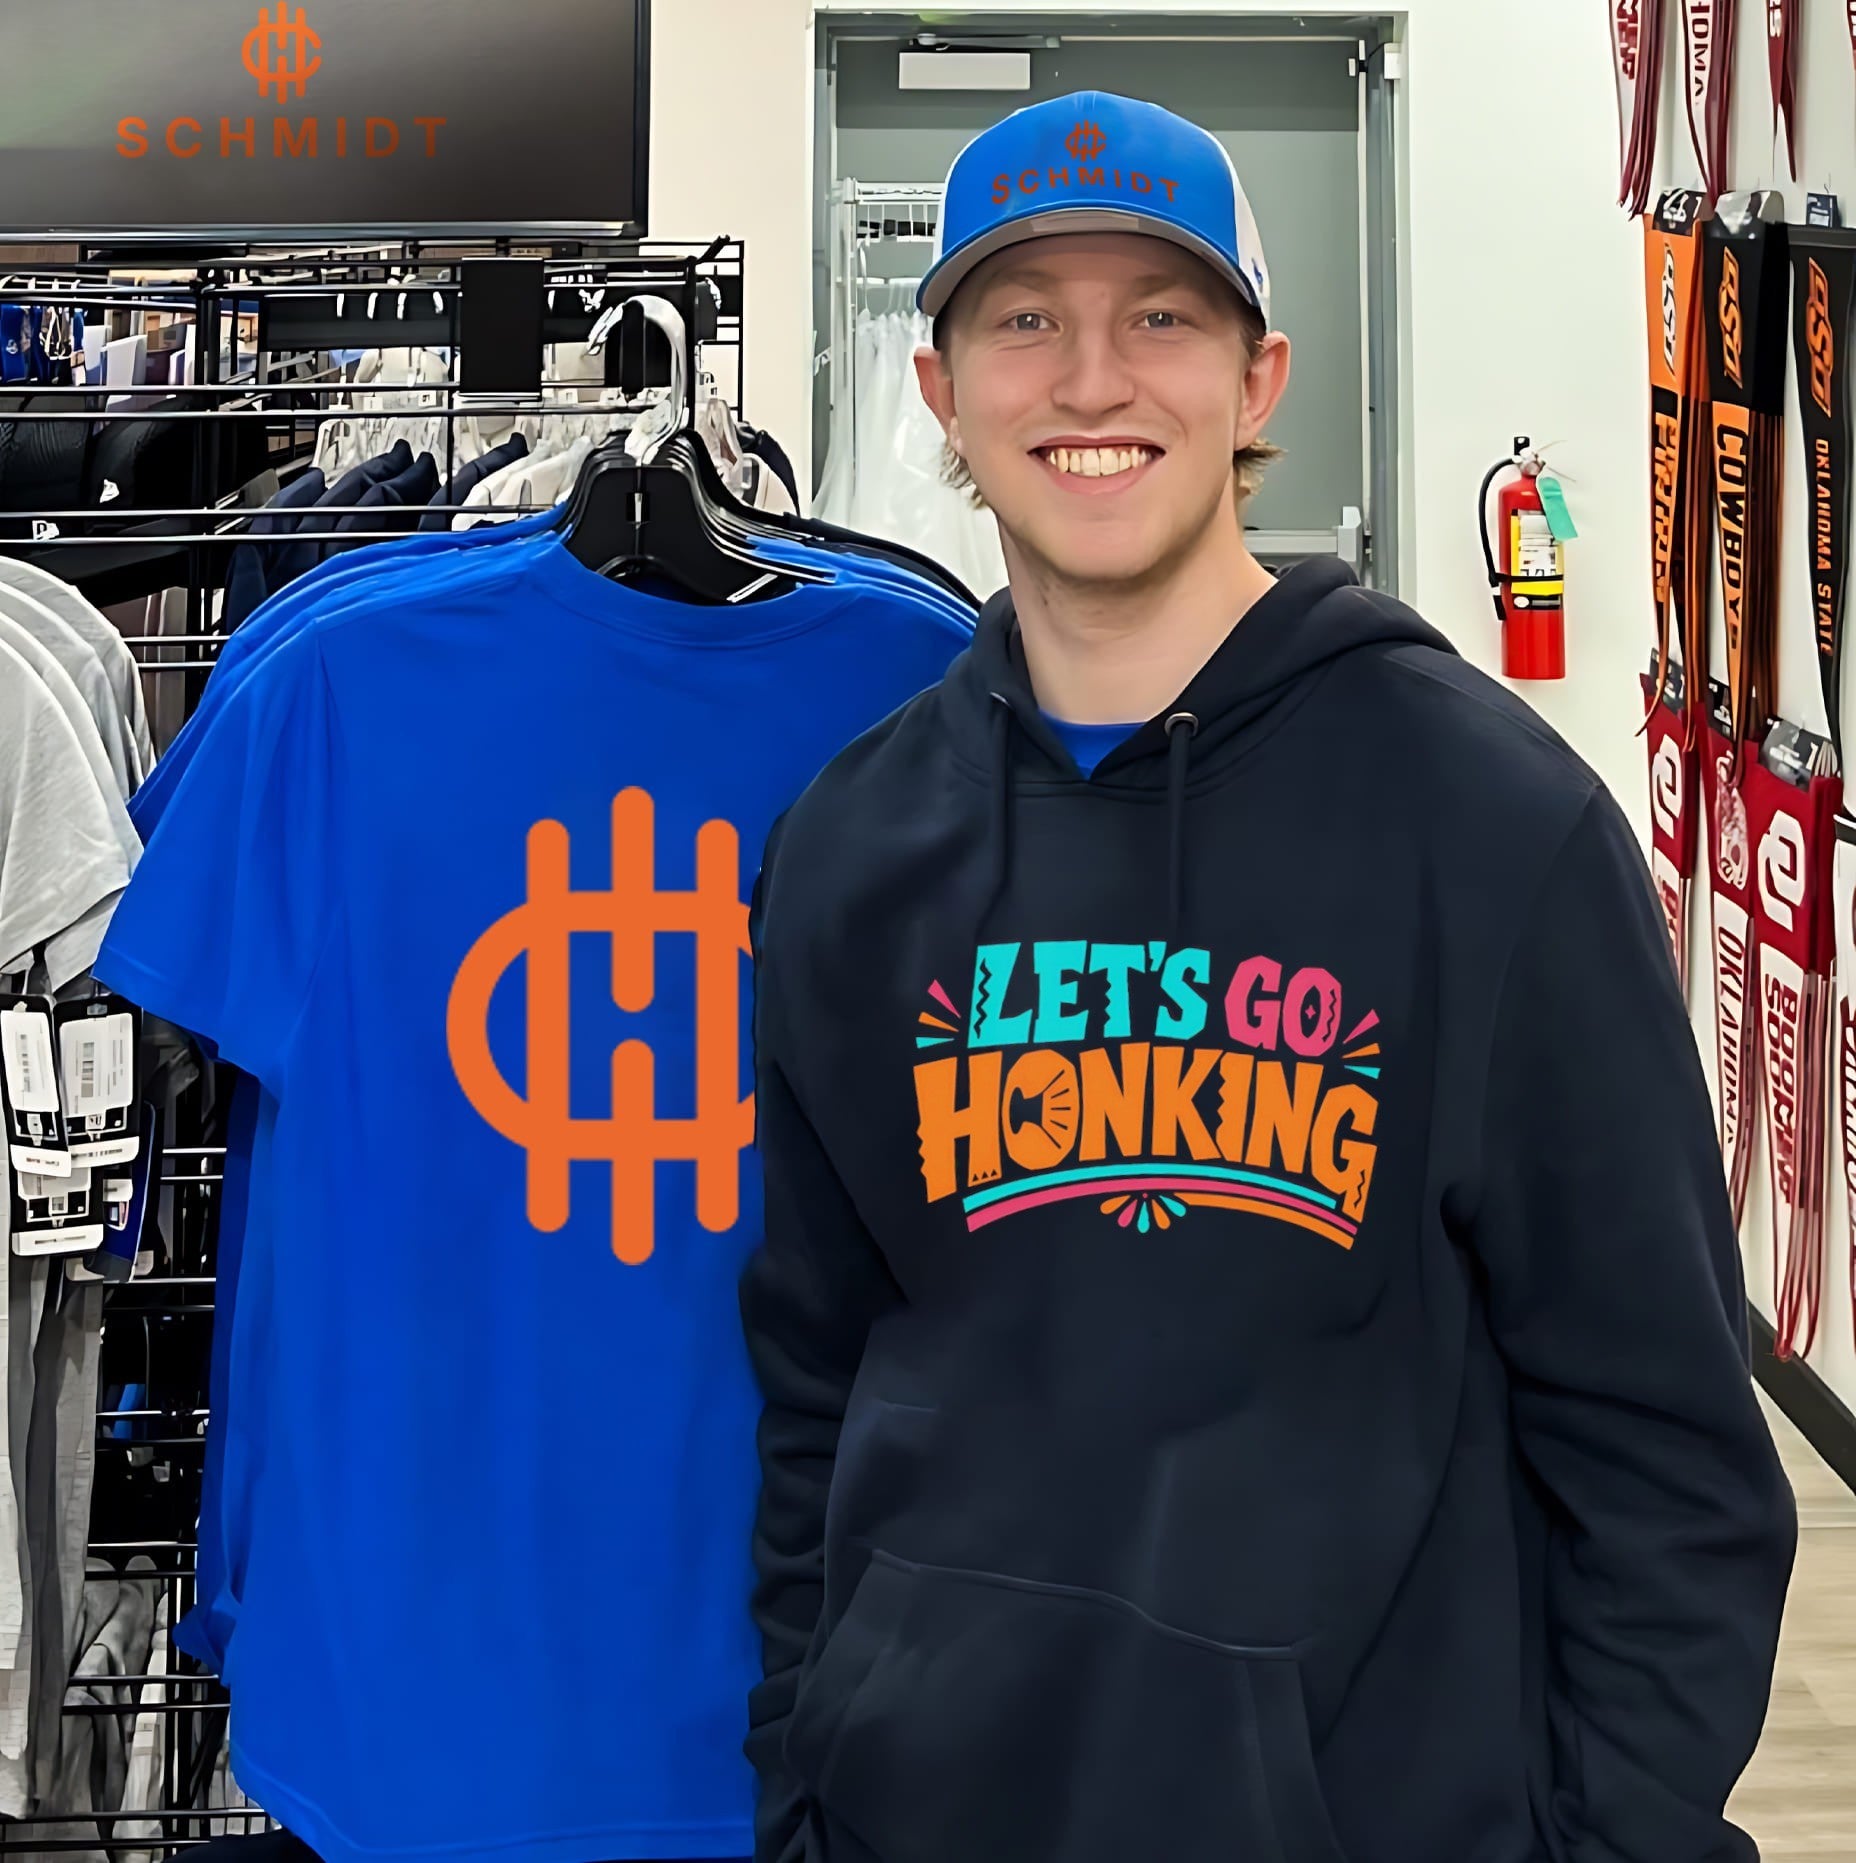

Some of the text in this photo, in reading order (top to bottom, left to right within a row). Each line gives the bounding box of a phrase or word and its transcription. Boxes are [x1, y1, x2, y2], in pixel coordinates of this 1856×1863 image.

[116, 116, 448, 158] SCHMIDT
[991, 166, 1180, 205] SCHMIDT
[1814, 438, 1832, 570] OKLAHOMA
[967, 940, 1342, 1057] LET'S GO
[1717, 925, 1744, 1144] OKLAHOMA
[913, 1041, 1379, 1224] HONKING
